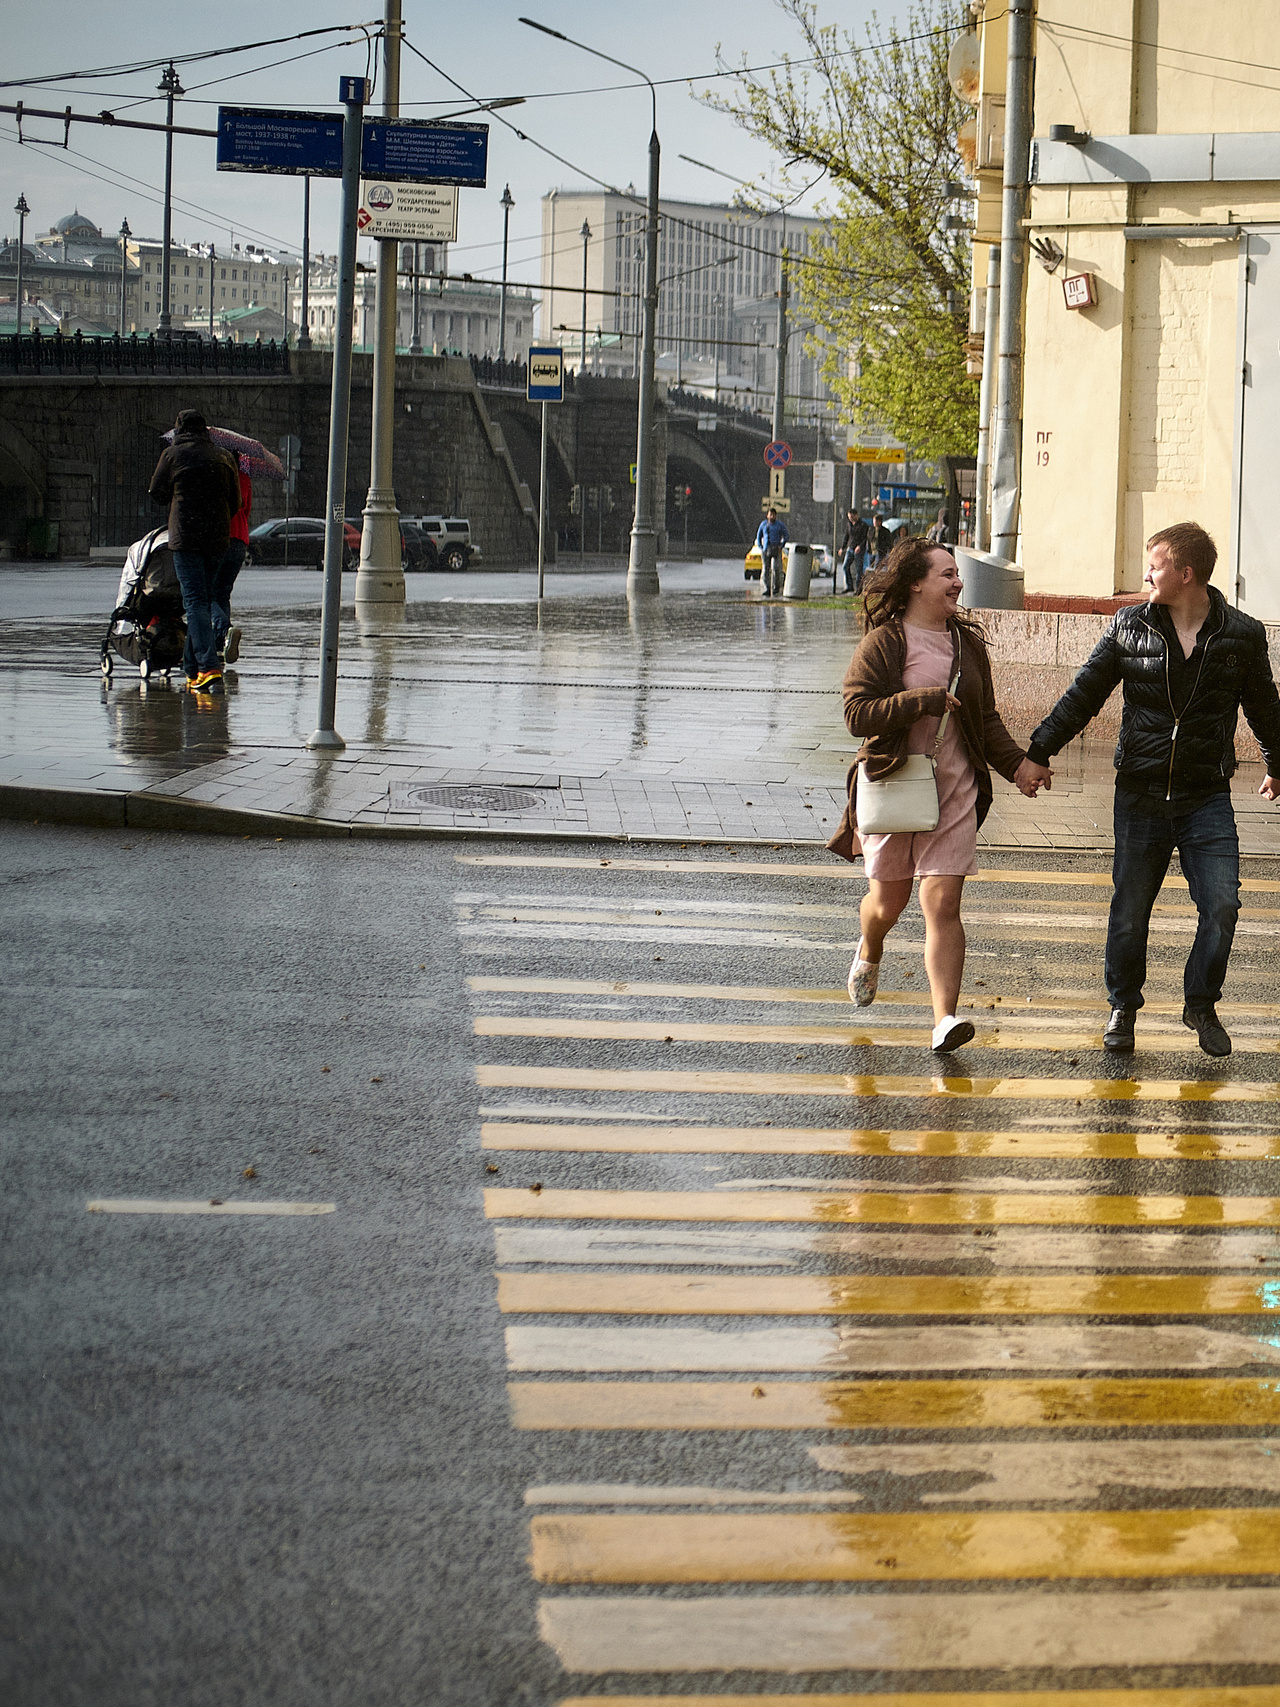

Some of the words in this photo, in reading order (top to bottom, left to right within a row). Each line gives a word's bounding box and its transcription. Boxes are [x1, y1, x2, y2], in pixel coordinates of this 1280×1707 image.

[236, 122, 266, 131] Большой
[267, 124, 317, 134] Москворецкий
[255, 131, 289, 140] 1937-1938
[386, 130, 428, 140] Скульптурная
[428, 134, 466, 142] композиция
[402, 138, 436, 146] Шемякина
[409, 146, 436, 154] пороков
[397, 187, 437, 196] МОСКОВСКИЙ
[396, 198, 452, 206] ГОСУДАРСТВЕННЫЙ
[386, 221, 402, 229] (495)
[367, 226, 416, 235] БЕРСЕНЕВСКАЯ
[436, 230, 452, 238] 20/2
[1068, 279, 1081, 294] ПГ
[1036, 450, 1050, 467] 19
